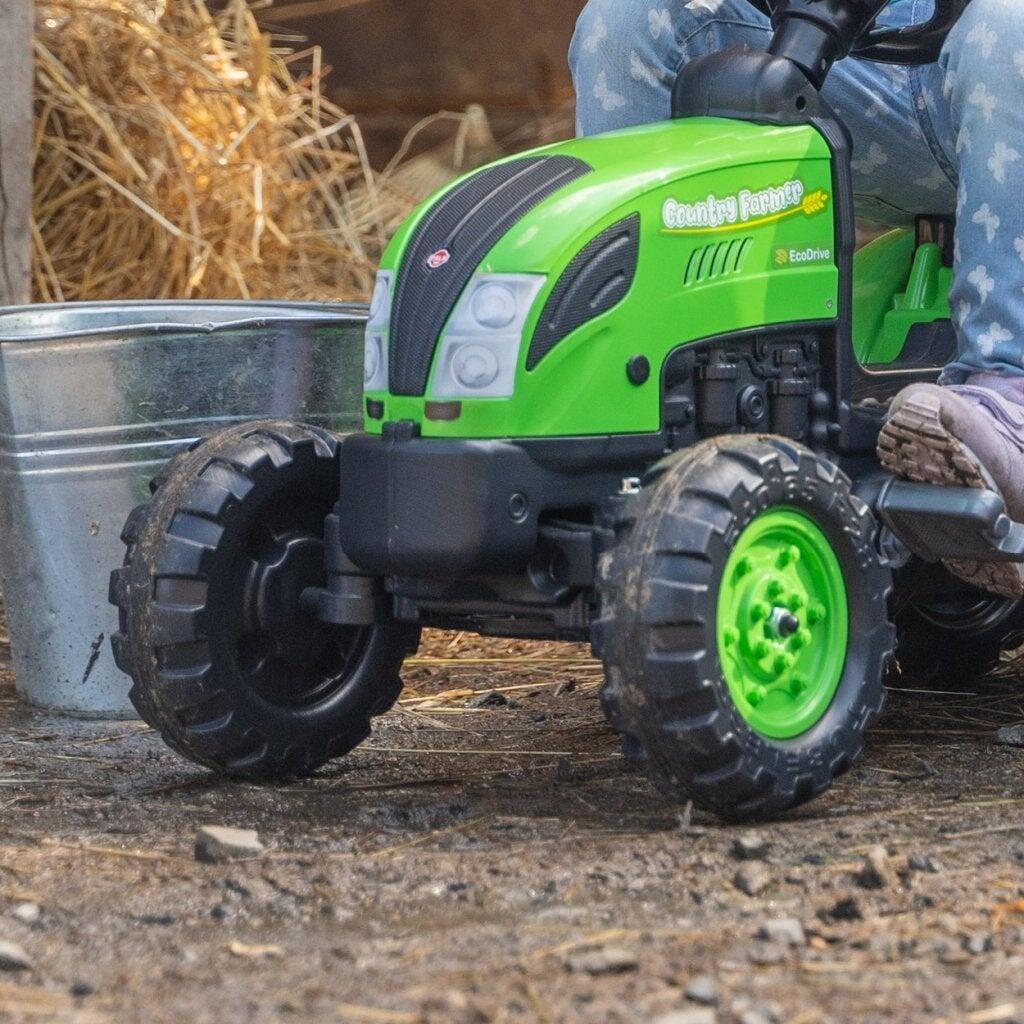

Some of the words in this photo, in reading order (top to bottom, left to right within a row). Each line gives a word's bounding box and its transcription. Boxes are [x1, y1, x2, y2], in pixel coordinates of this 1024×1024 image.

[663, 195, 737, 227] Country
[738, 180, 803, 220] Farmer
[789, 249, 830, 262] EcoDrive
